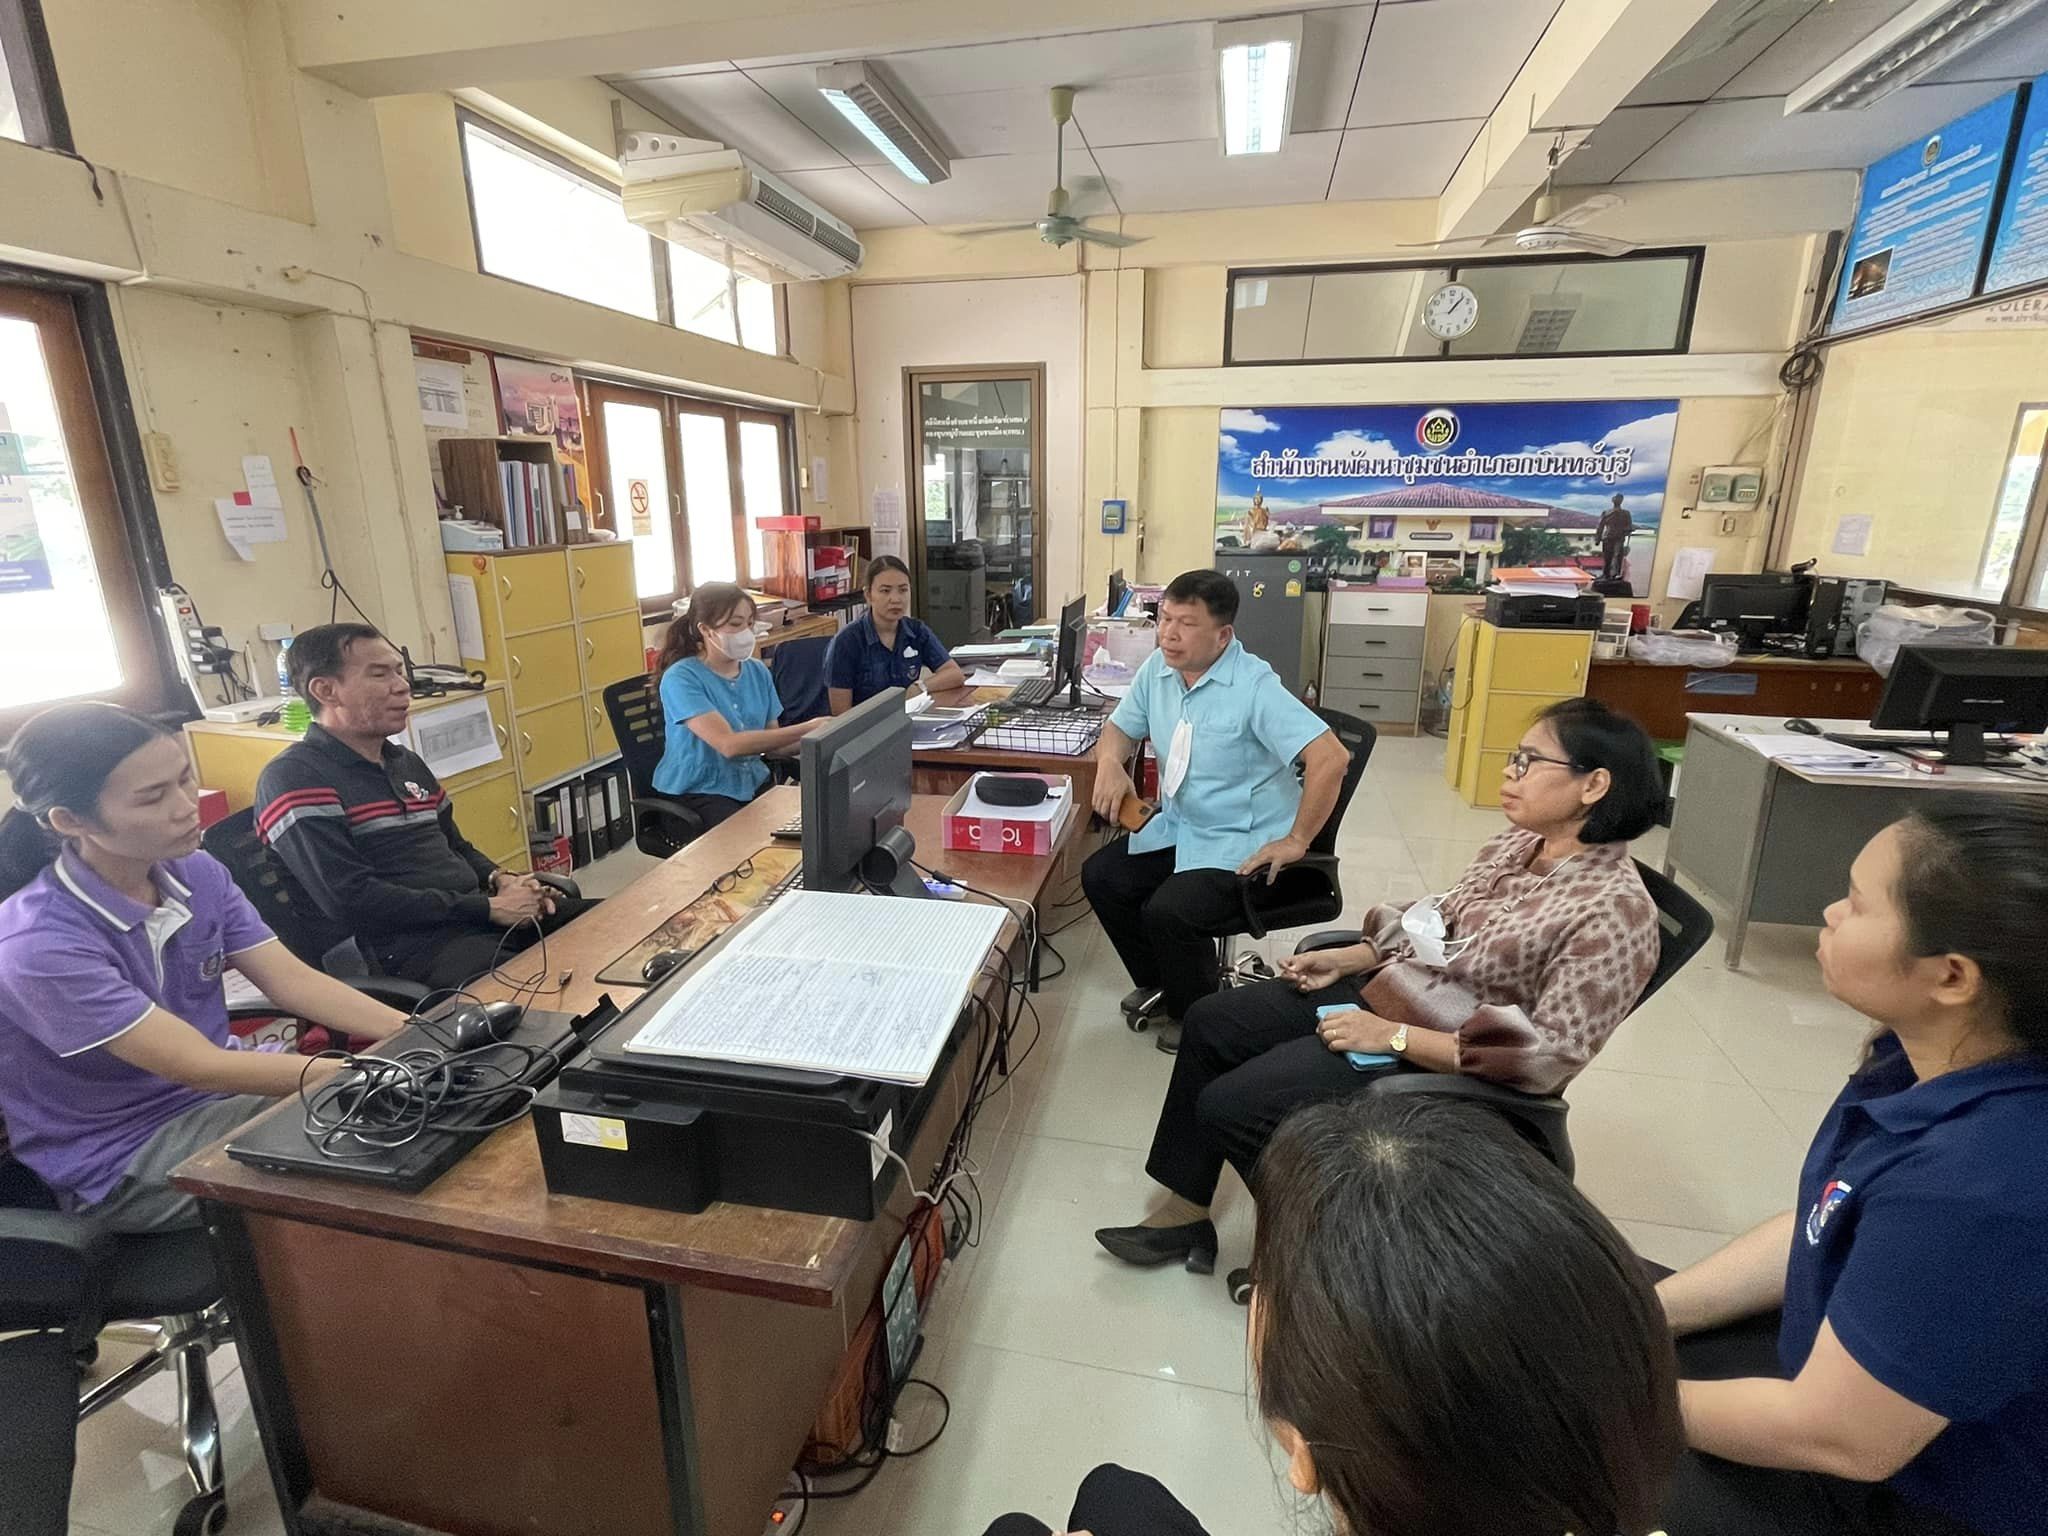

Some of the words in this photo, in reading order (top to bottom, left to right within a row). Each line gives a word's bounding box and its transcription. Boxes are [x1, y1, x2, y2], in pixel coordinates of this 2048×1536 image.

[1252, 442, 1632, 484] สำนักงานพัฒนาชุมชนอำเภอกบินทร์บุรี
[1226, 569, 1251, 577] FIT
